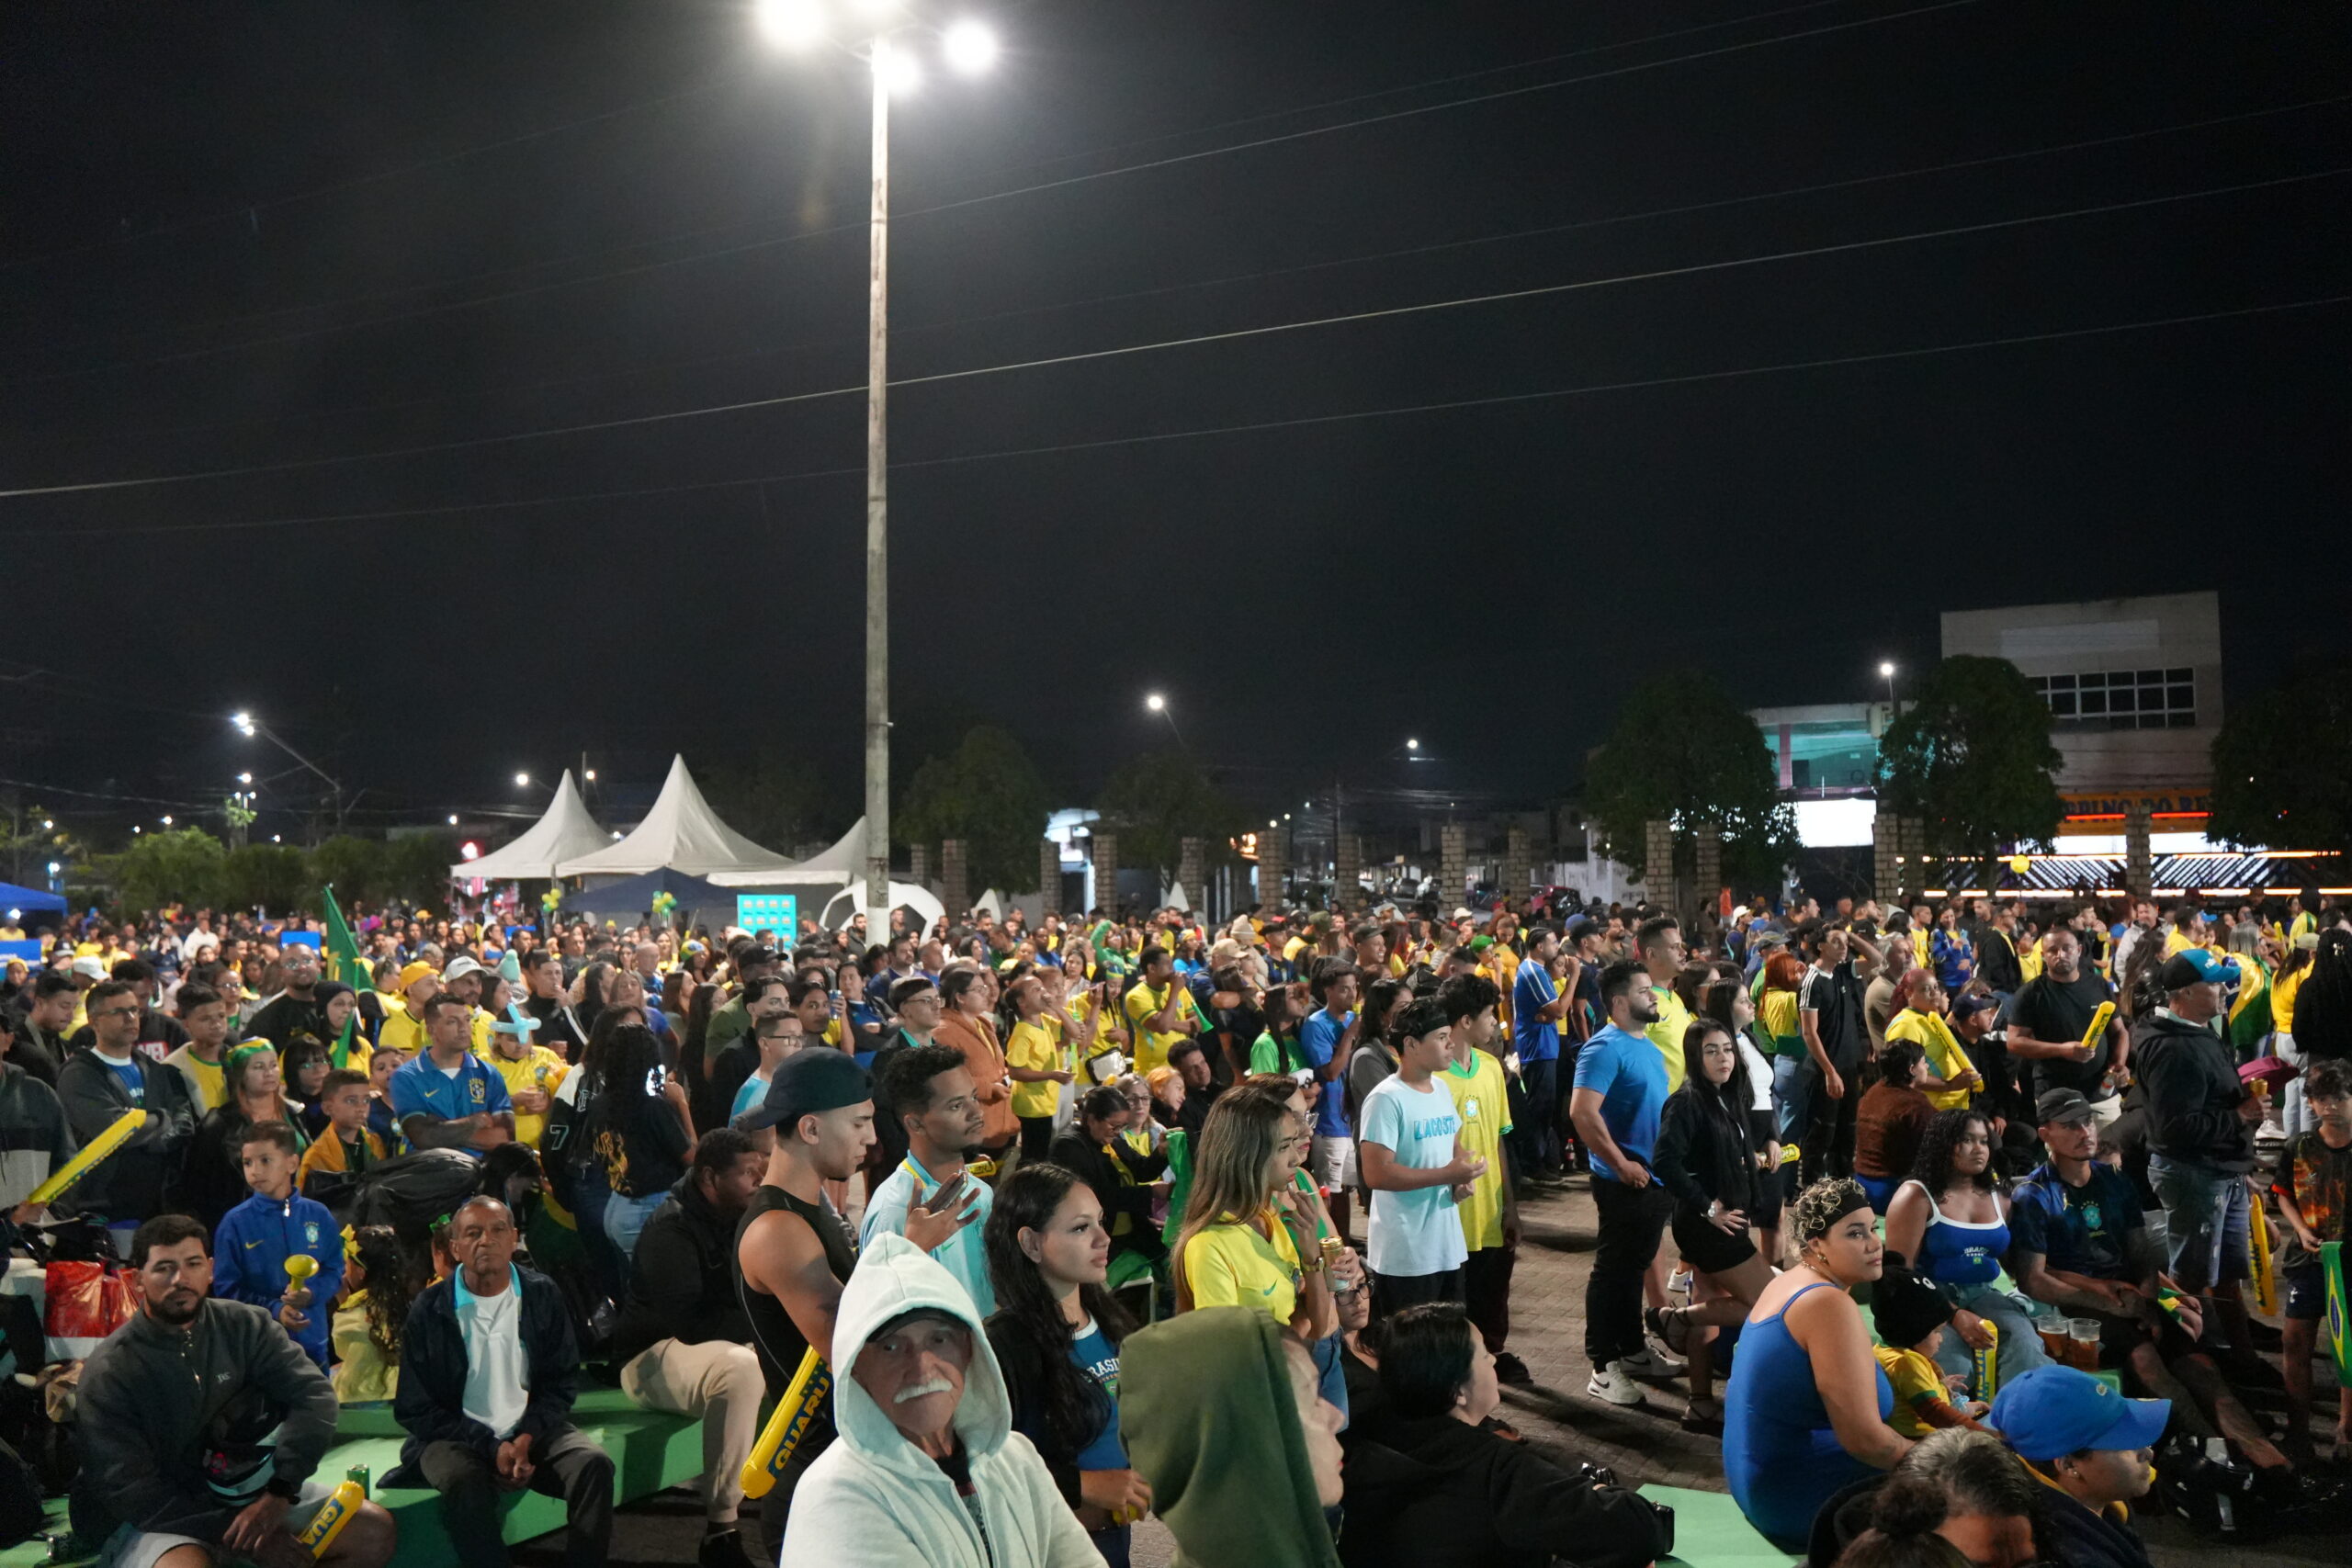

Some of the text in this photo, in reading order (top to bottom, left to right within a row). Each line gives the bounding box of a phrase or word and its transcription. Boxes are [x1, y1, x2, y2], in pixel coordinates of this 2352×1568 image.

[549, 1124, 570, 1151] 7
[1414, 1116, 1456, 1140] LACOSTE
[775, 1378, 830, 1472] GUARU
